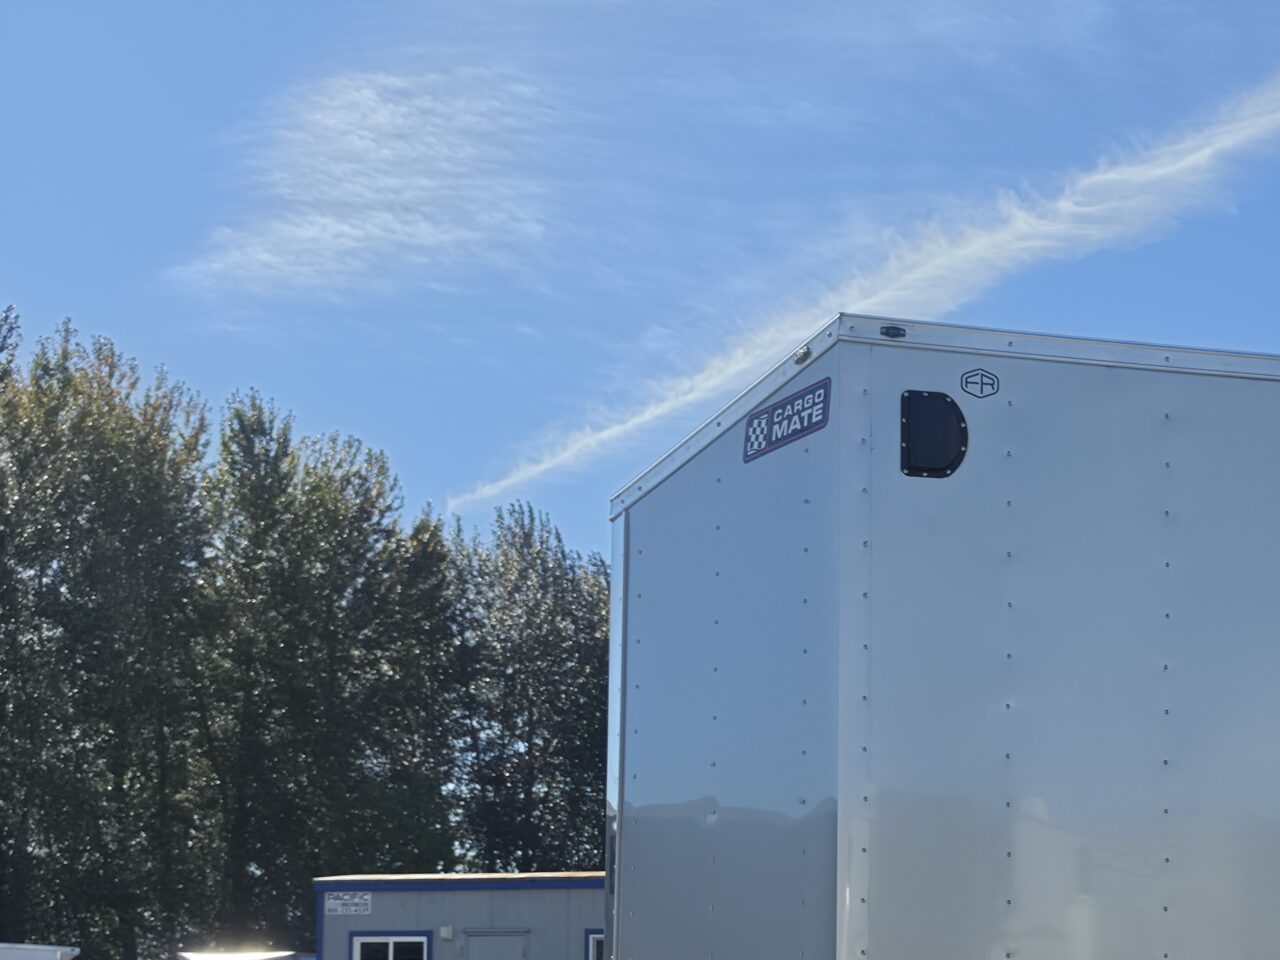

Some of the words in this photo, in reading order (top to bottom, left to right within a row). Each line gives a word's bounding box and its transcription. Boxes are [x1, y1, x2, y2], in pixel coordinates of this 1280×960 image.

[772, 402, 824, 441] MATE
[773, 388, 824, 422] CARGO
[327, 892, 369, 901] PACIFIC
